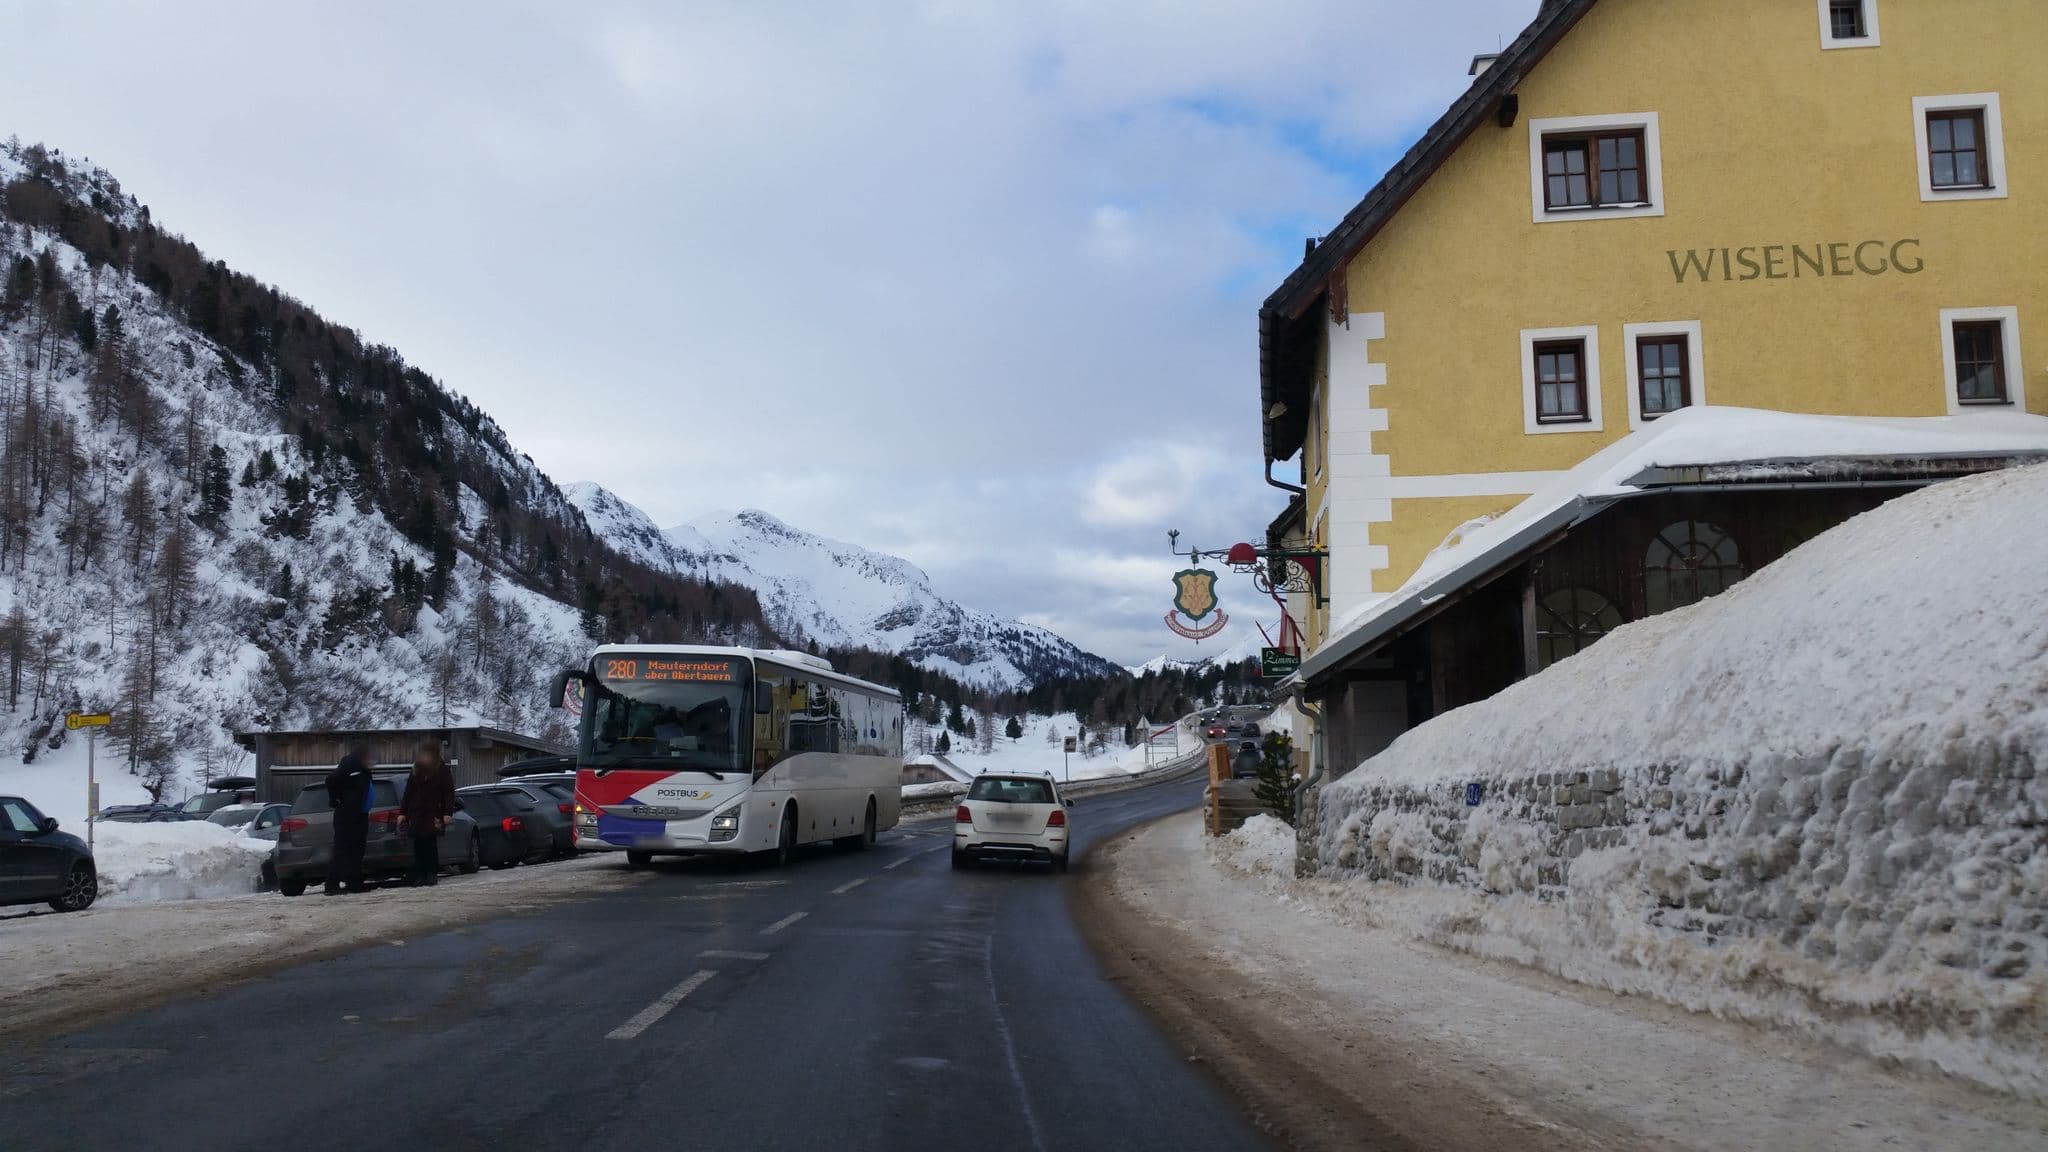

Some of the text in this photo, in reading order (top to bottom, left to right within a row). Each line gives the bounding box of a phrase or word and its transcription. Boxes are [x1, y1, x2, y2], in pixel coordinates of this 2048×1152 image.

[1666, 238, 1925, 283] WISENEGG
[607, 660, 636, 679] 280
[648, 661, 729, 671] Mauterndorf
[671, 671, 731, 681] Obertauern
[70, 716, 78, 727] H
[657, 789, 699, 797] POSTBUS
